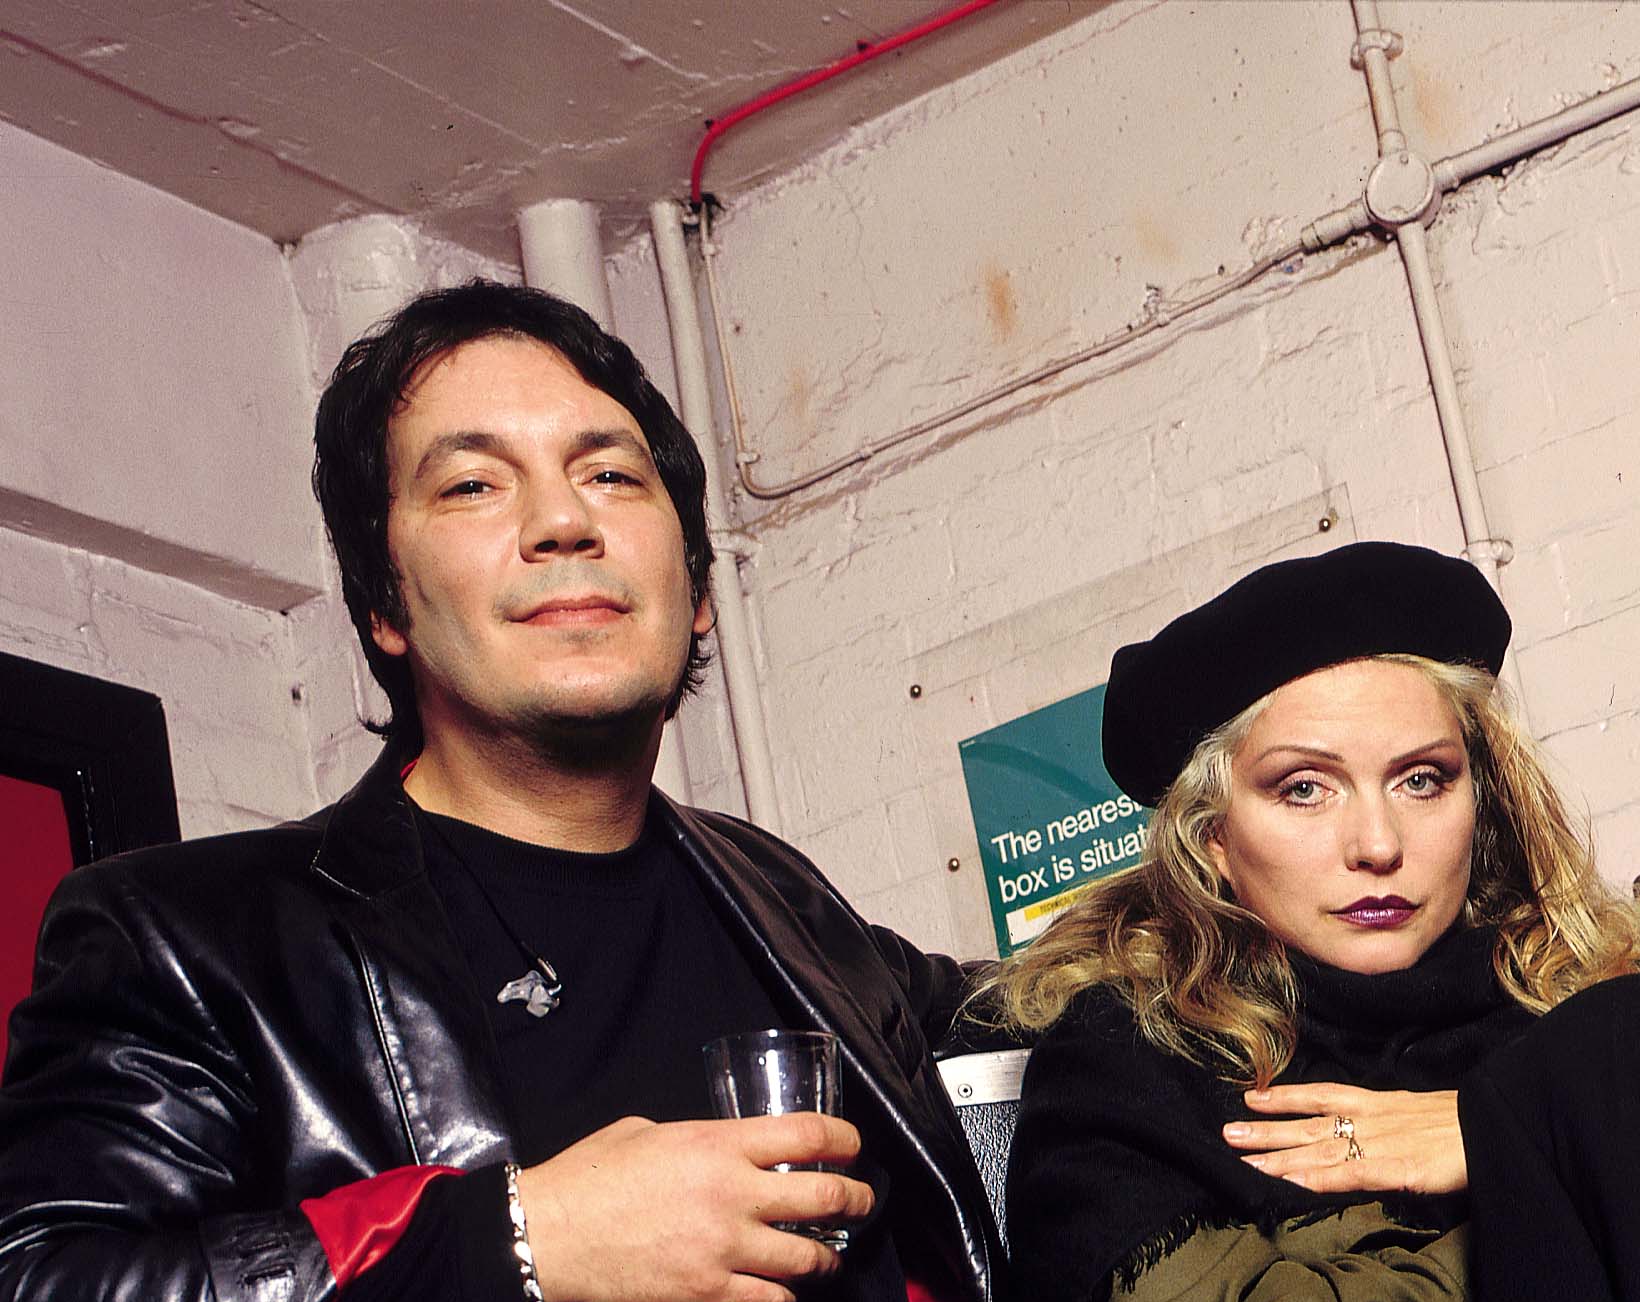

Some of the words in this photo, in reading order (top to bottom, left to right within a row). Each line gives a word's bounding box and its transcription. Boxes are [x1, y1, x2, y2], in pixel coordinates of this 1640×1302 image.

[991, 831, 1042, 863] The
[998, 869, 1049, 903] box
[1051, 856, 1075, 883] is
